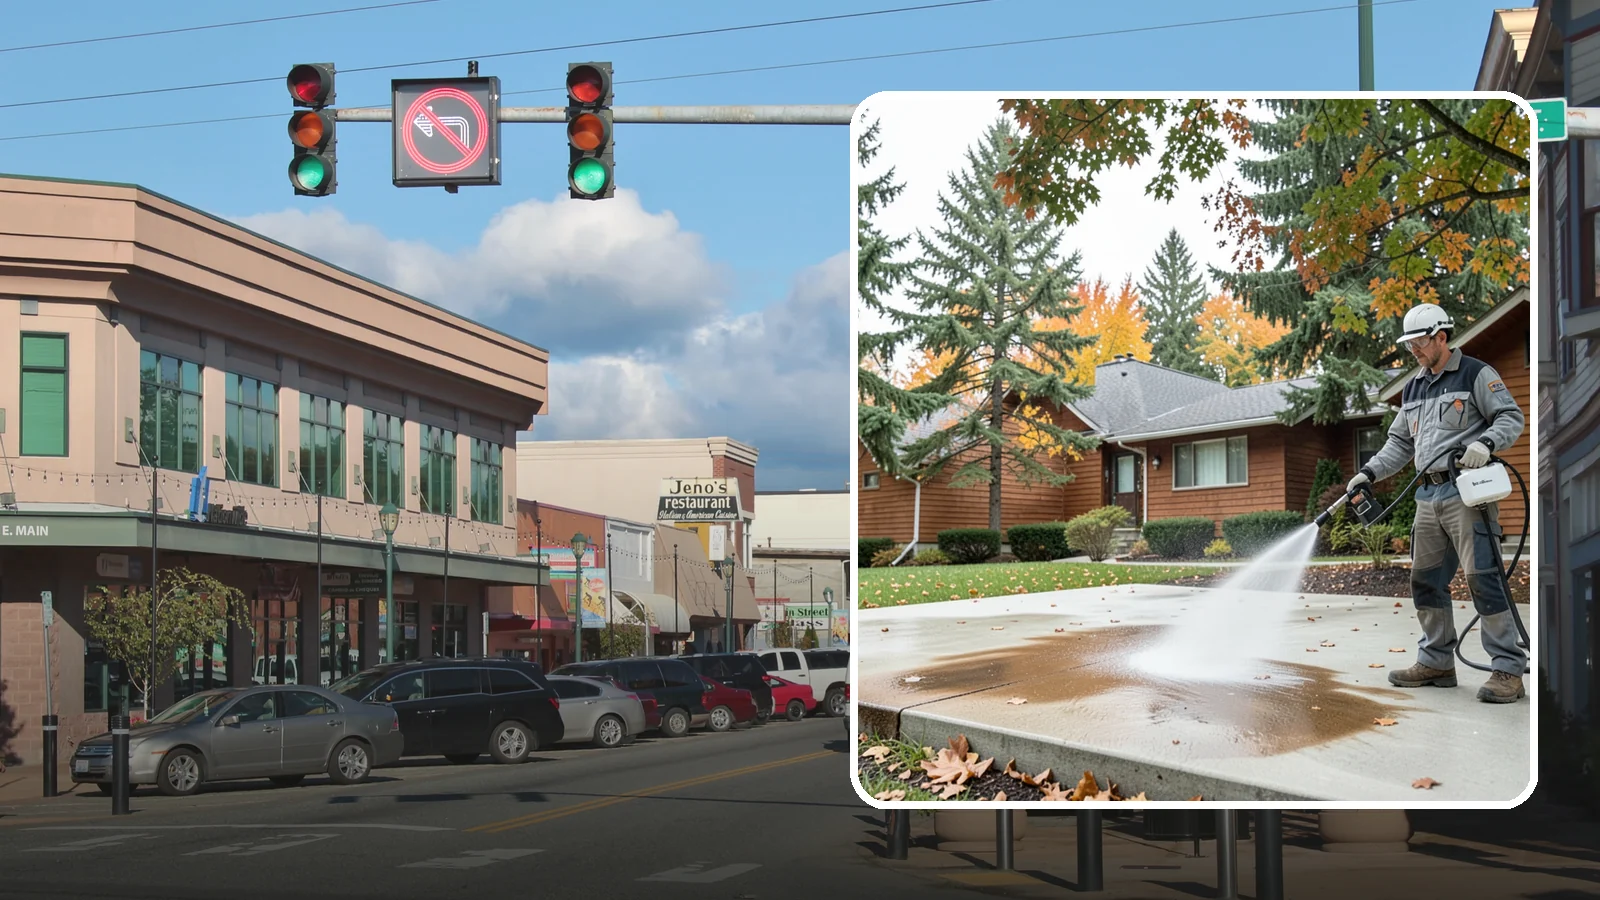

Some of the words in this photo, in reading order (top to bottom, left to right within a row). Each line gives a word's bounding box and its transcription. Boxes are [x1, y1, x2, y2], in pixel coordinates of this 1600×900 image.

[670, 480, 727, 494] Jeno's
[665, 496, 731, 509] restaurant
[658, 510, 682, 519] Italian
[686, 509, 715, 519] American
[714, 509, 737, 519] Cuisine
[2, 525, 13, 536] E.
[15, 525, 49, 536] MAIN
[797, 607, 829, 617] Street
